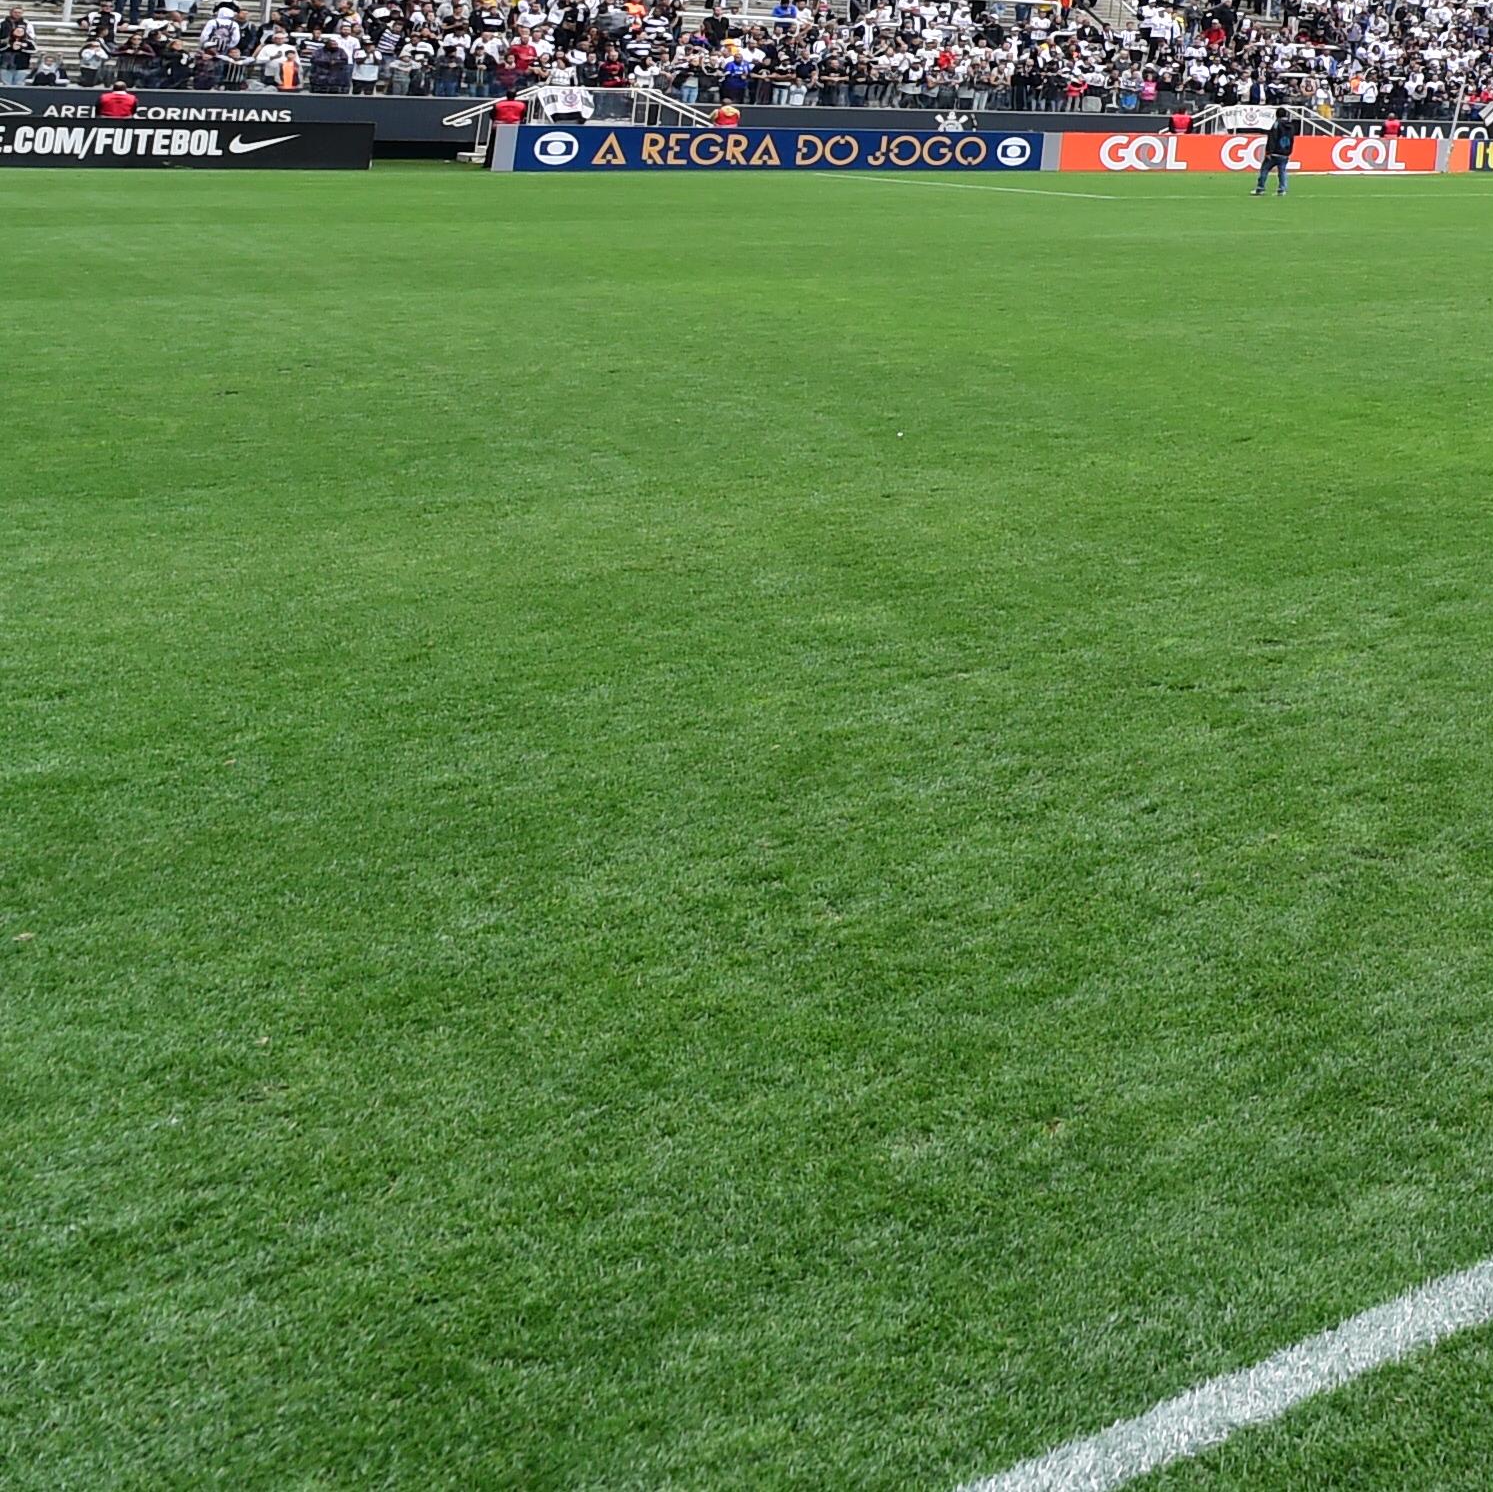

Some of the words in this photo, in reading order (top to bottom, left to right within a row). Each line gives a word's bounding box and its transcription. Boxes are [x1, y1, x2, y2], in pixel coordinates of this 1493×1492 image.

[132, 107, 292, 122] CORINTHIANS
[592, 132, 626, 165] A
[641, 133, 781, 166] REGRA
[796, 134, 859, 166] DO
[867, 135, 987, 167] JOGO
[1099, 135, 1188, 171] GOL
[1331, 138, 1406, 171] GOL
